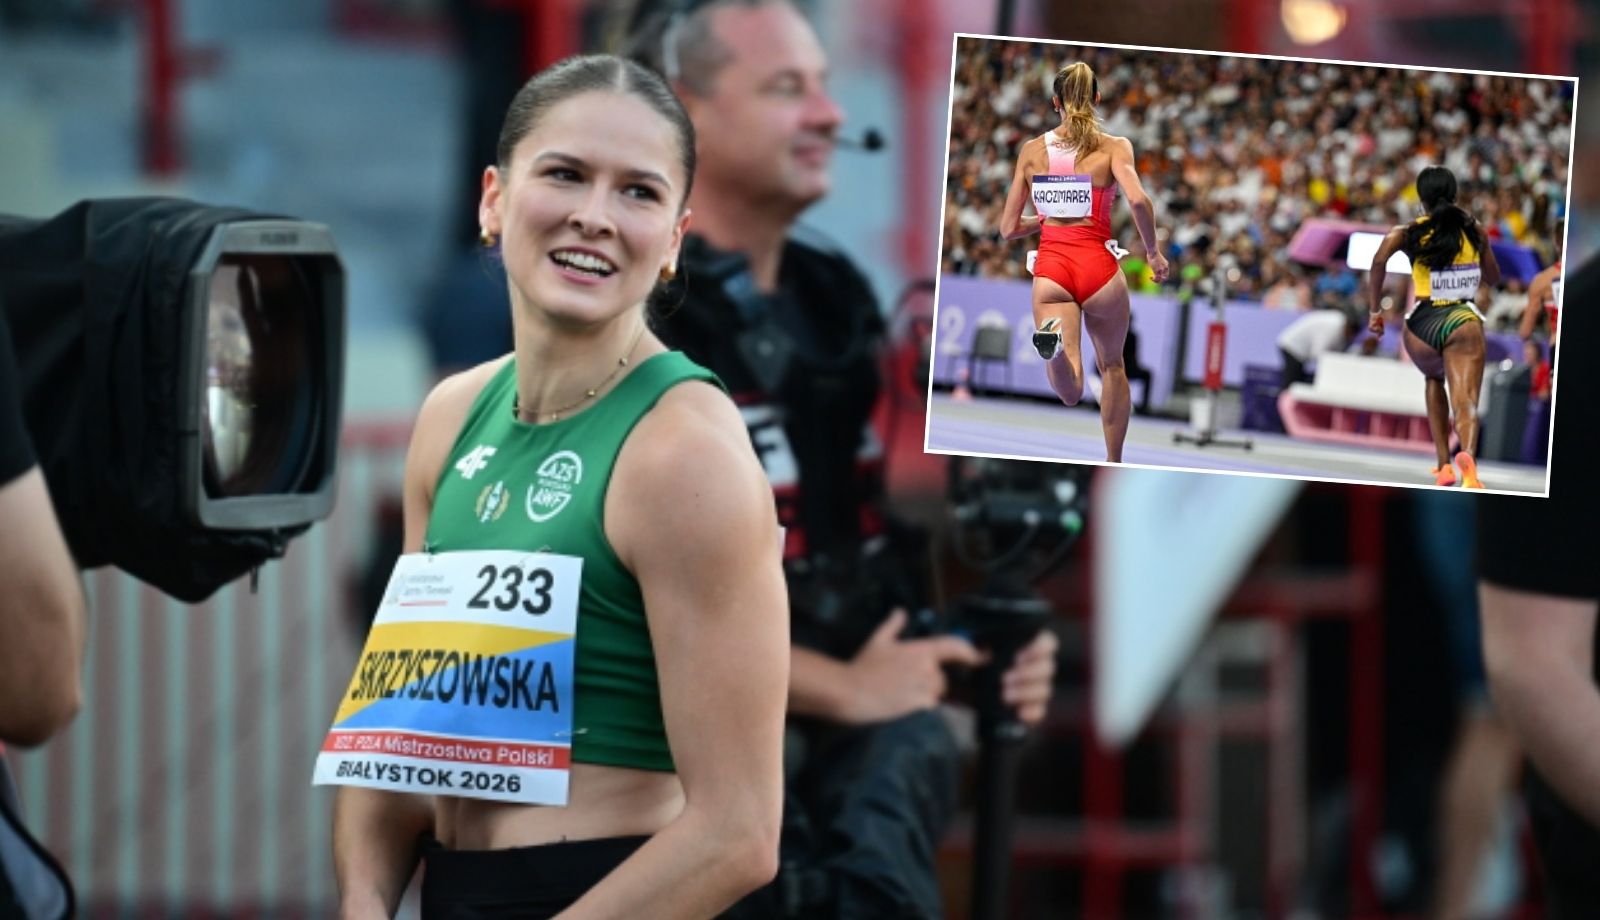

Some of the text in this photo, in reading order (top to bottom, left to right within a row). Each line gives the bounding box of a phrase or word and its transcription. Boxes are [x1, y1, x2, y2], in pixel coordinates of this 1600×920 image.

[1033, 189, 1091, 204] KACZMAREK
[455, 445, 498, 480] 4F
[466, 564, 556, 616] 233
[351, 649, 560, 714] SKRZYSZOWSKA
[384, 735, 492, 762] Mistrzostwa
[496, 746, 555, 767] Polski
[336, 760, 522, 793] BIAŁYSTOK 2026
